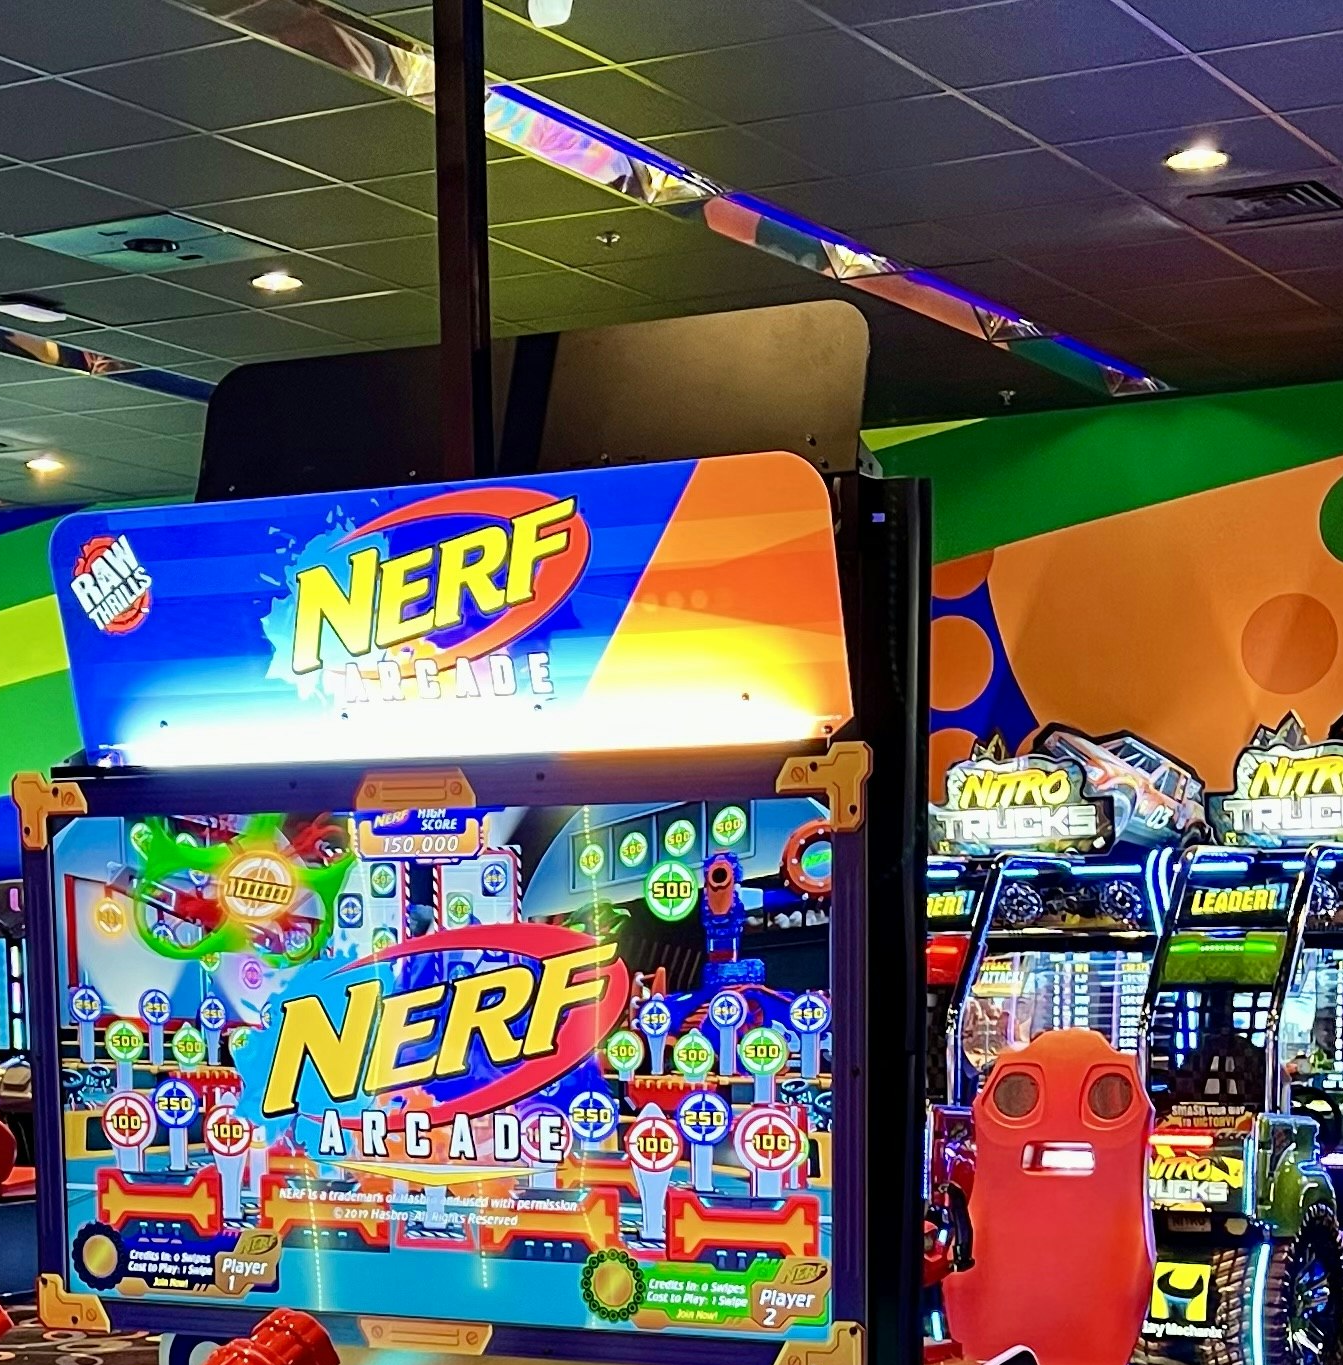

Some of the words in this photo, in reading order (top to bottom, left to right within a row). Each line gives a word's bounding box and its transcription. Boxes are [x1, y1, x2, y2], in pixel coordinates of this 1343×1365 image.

[71, 535, 140, 604] RAW
[292, 496, 578, 675] NERF
[87, 567, 152, 632] THRILLS
[345, 652, 555, 704] ARCADE
[420, 818, 458, 832] SCORE
[936, 805, 1097, 840] TRUCKS
[383, 835, 459, 855] 150,000
[652, 881, 692, 899] 500
[1191, 888, 1277, 914] LEADER!
[793, 1009, 824, 1020] 250
[263, 943, 618, 1118] NERF
[112, 1037, 139, 1047] 500
[176, 1042, 202, 1052] 500
[611, 1046, 636, 1057] 500
[678, 1050, 708, 1062] 500
[745, 1045, 779, 1059] 500
[158, 1097, 192, 1111] 250
[111, 1115, 142, 1130] 100
[572, 1108, 611, 1123] 250
[684, 1110, 726, 1126] 250
[213, 1124, 244, 1139] 100
[319, 1108, 565, 1163] ARCADE
[637, 1138, 673, 1153] 100
[754, 1135, 789, 1151] 100
[222, 1258, 268, 1276] Player
[759, 1289, 816, 1309] Player
[762, 1308, 777, 1326] 2
